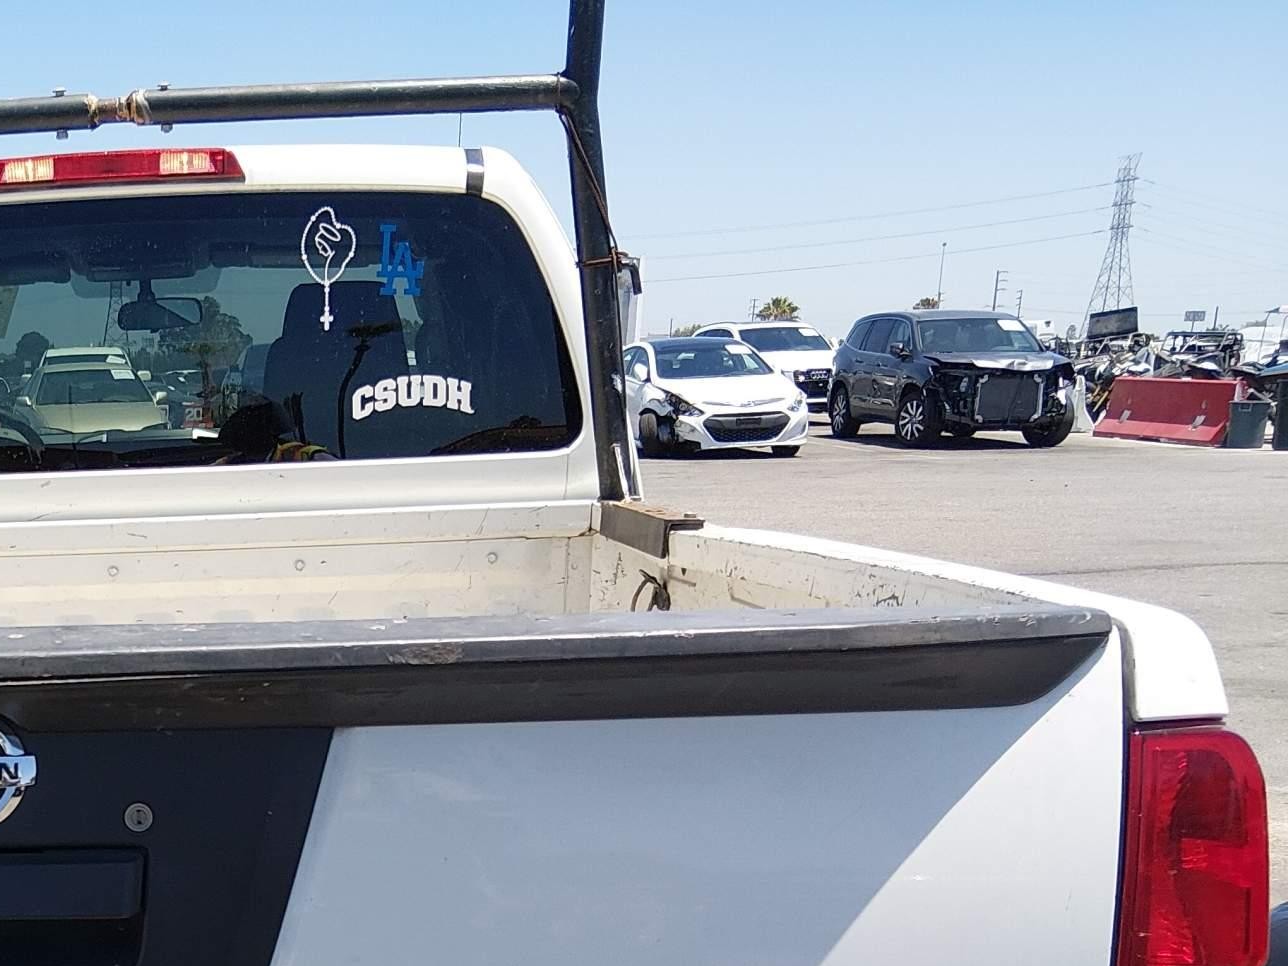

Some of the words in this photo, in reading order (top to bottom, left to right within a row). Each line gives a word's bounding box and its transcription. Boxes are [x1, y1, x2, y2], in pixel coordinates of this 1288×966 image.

[376, 224, 424, 295] LA
[184, 408, 203, 420] 20
[352, 374, 475, 420] CSUDH
